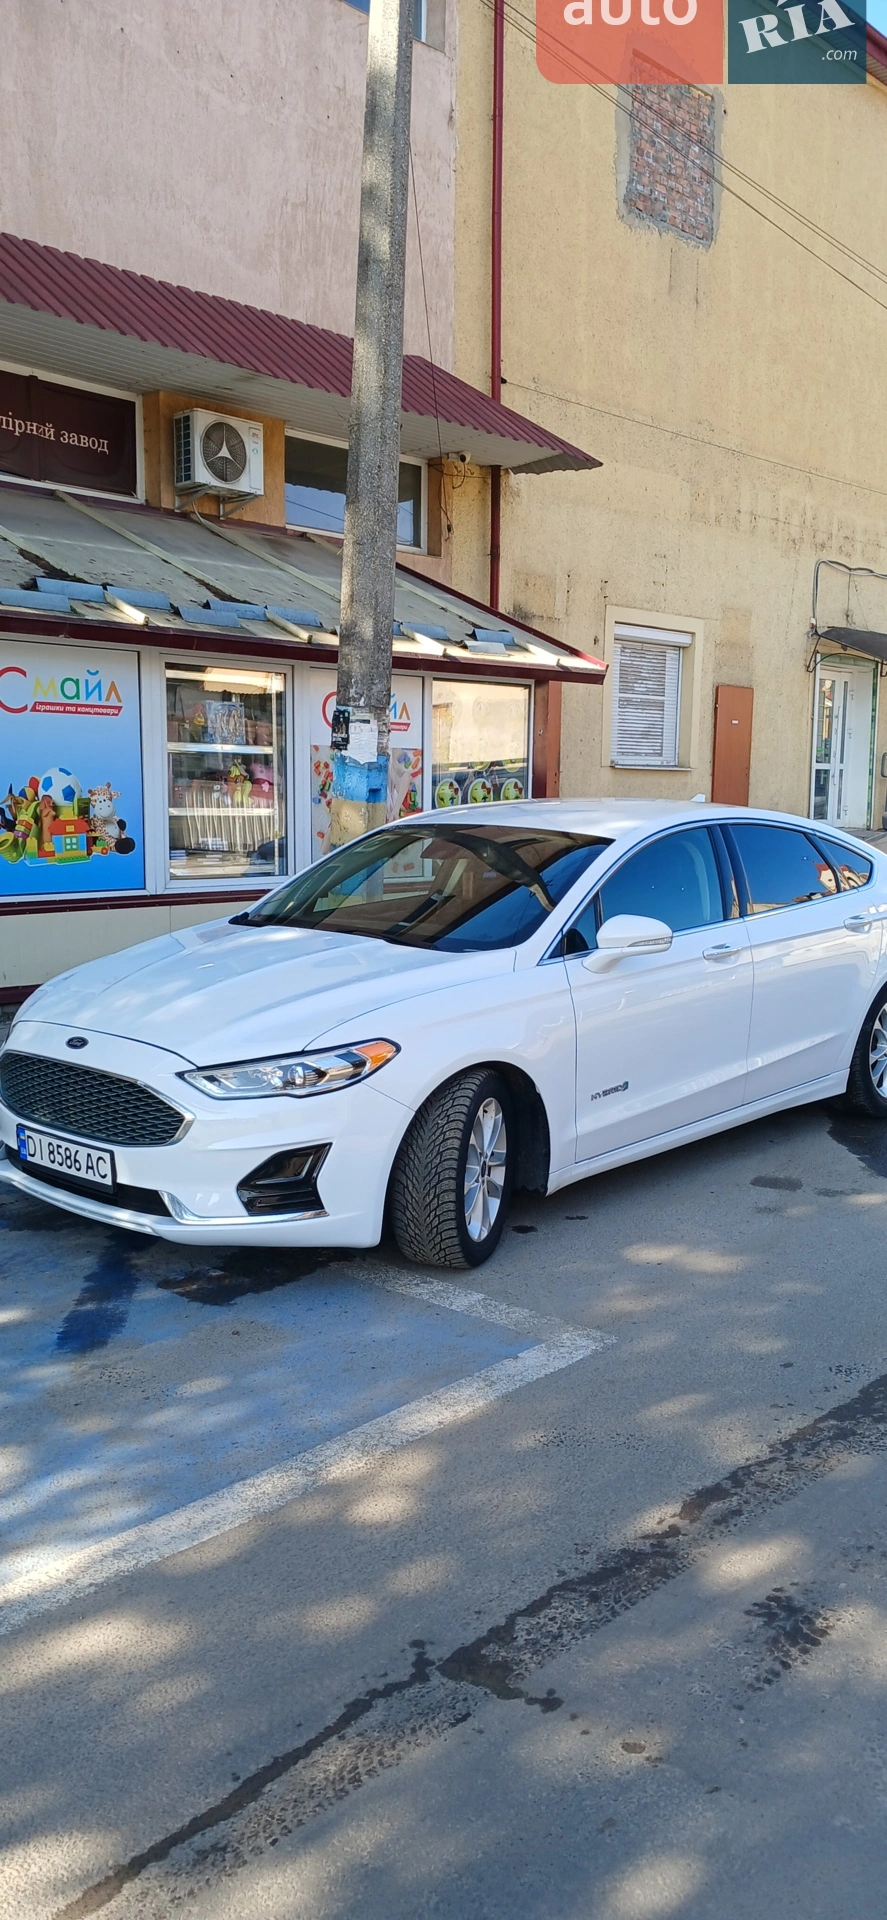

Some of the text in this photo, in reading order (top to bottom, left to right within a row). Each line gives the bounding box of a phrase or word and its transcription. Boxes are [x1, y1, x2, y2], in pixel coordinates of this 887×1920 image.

[60, 430, 109, 455] завод
[0, 666, 122, 714] Смайл
[36, 703, 64, 712] іграшки
[27, 1135, 108, 1179] DI 8586 AC
